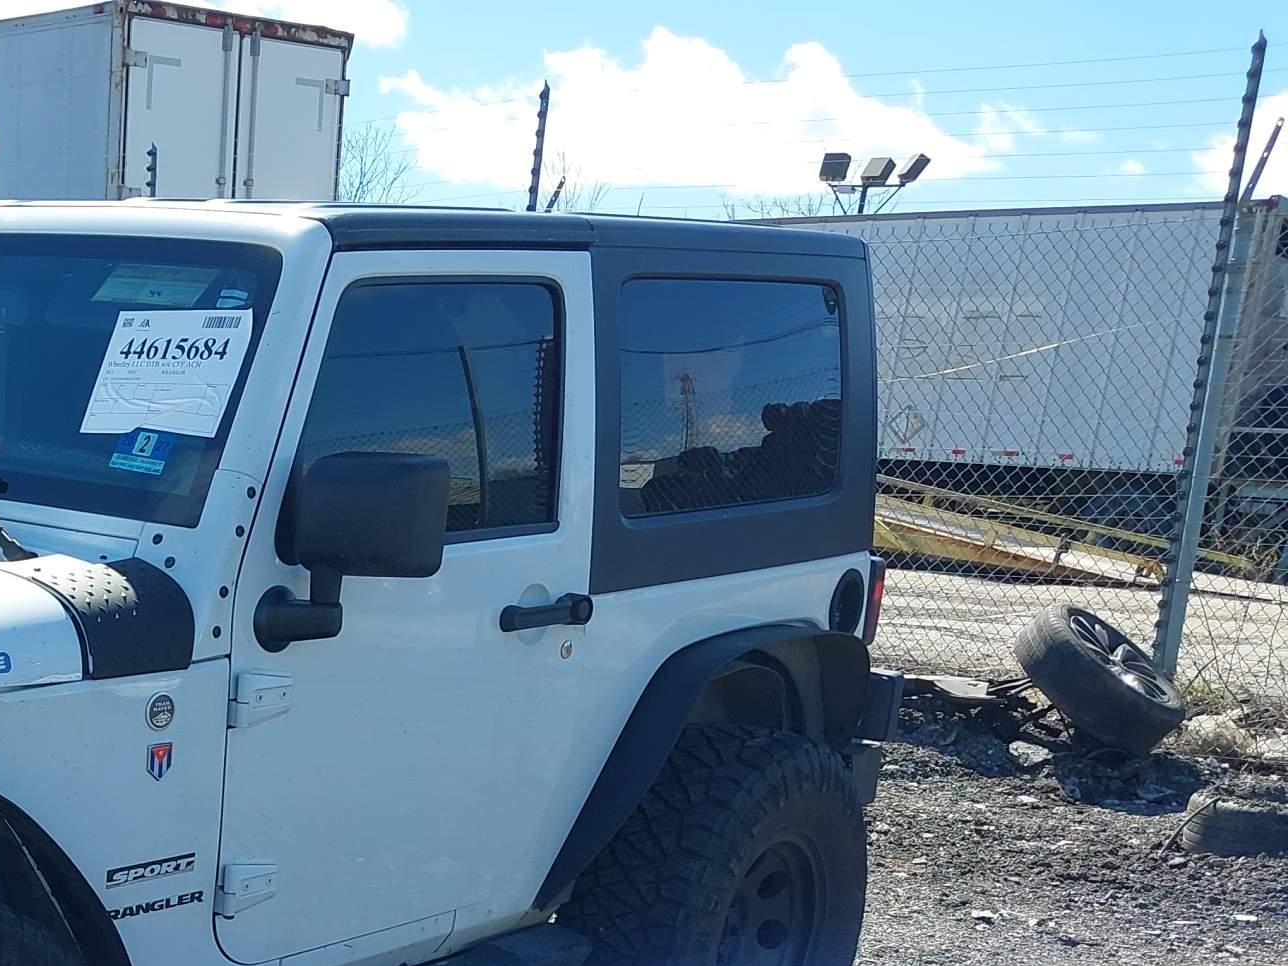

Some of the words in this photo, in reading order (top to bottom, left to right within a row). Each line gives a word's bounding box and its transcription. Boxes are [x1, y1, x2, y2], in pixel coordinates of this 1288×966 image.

[120, 337, 231, 360] 44615684
[138, 434, 152, 453] 2
[110, 858, 195, 886] SPORT
[108, 890, 204, 920] RANGLER
